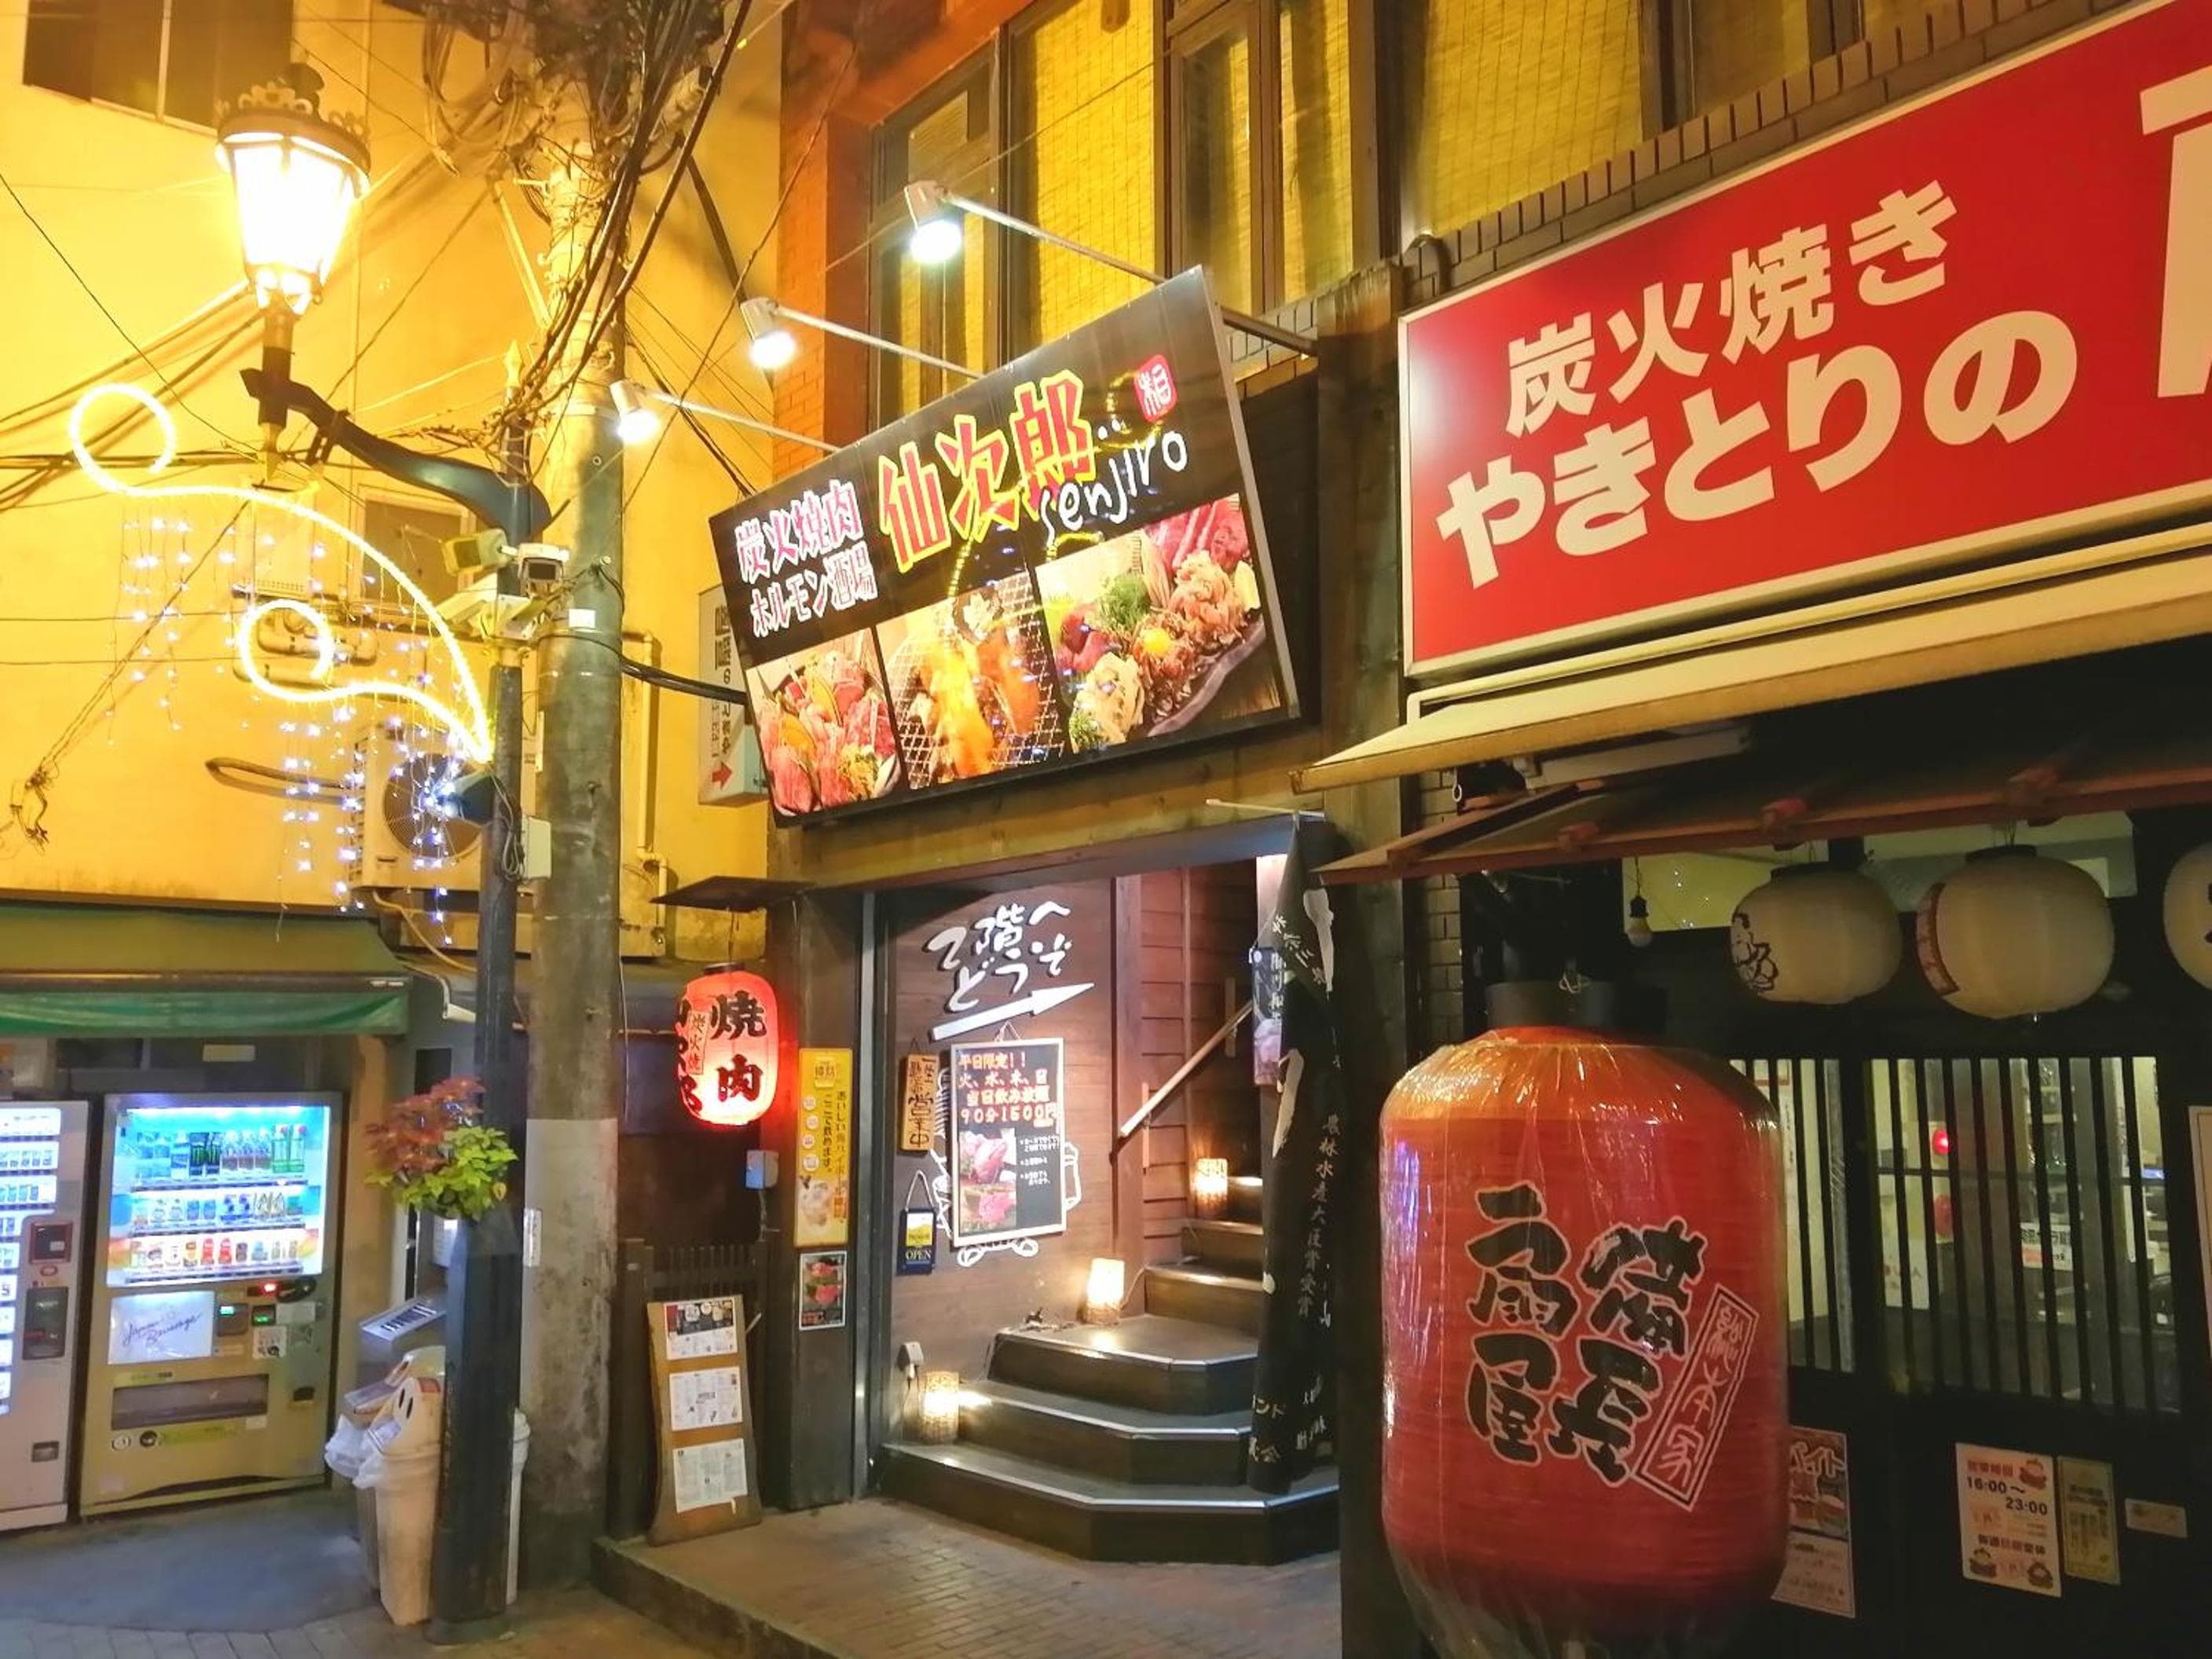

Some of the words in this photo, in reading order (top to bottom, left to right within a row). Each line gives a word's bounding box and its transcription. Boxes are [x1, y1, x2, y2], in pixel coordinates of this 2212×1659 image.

[1504, 179, 1957, 439] 炭火焼き
[877, 368, 1097, 573] 仙次郎
[1435, 309, 2078, 590] やきとりの
[734, 479, 863, 584] 炭火焼肉
[750, 540, 878, 638] ホルモン酒場
[948, 933, 1073, 1012] どうぞ
[710, 991, 767, 1101] 焼肉
[1465, 1181, 1580, 1463] 扇屋
[2005, 1496, 2048, 1516] 23:00
